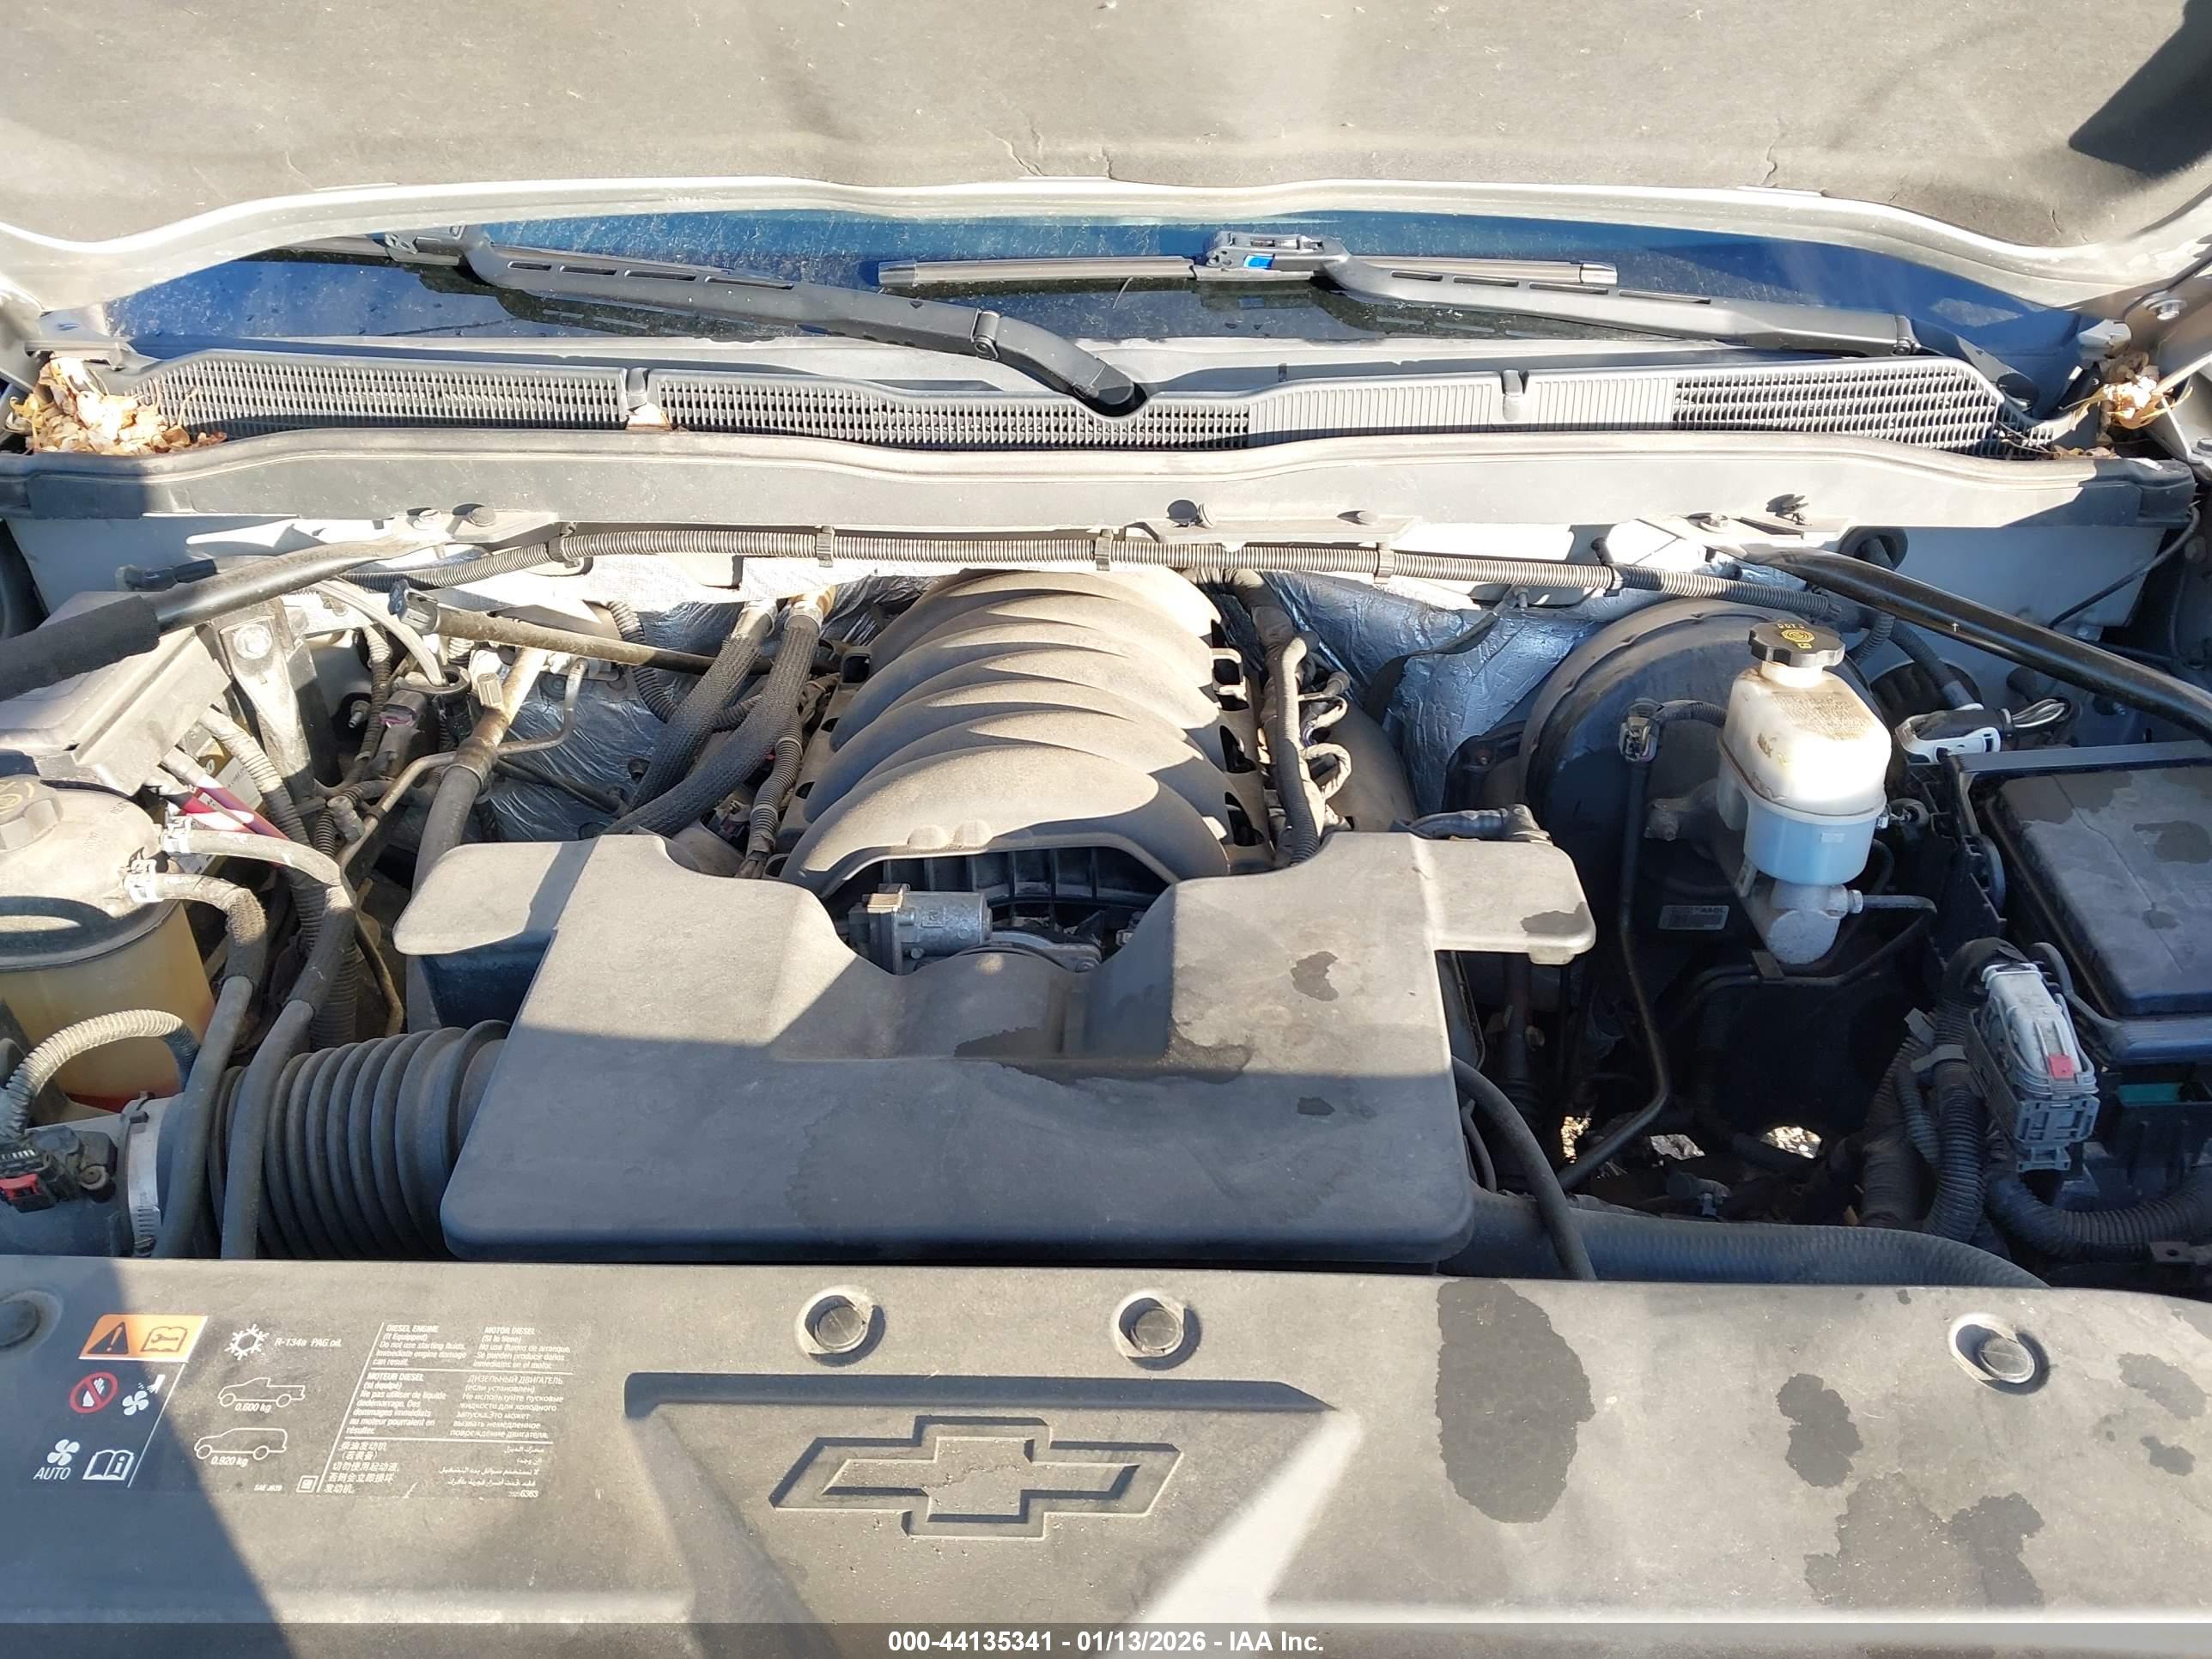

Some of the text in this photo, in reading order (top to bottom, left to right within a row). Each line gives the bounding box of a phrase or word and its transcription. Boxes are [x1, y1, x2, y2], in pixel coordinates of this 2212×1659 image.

[386, 1324, 410, 1333] DIESEL
[275, 1338, 306, 1346] R-134a
[311, 1338, 328, 1346] PAG
[367, 1372, 398, 1381] MOTEUR
[519, 1376, 563, 1384] ДВИГАТЕЛЬ
[260, 1403, 271, 1413] kg
[211, 1456, 248, 1467] 0.920 kg
[33, 1467, 71, 1480] AUTO
